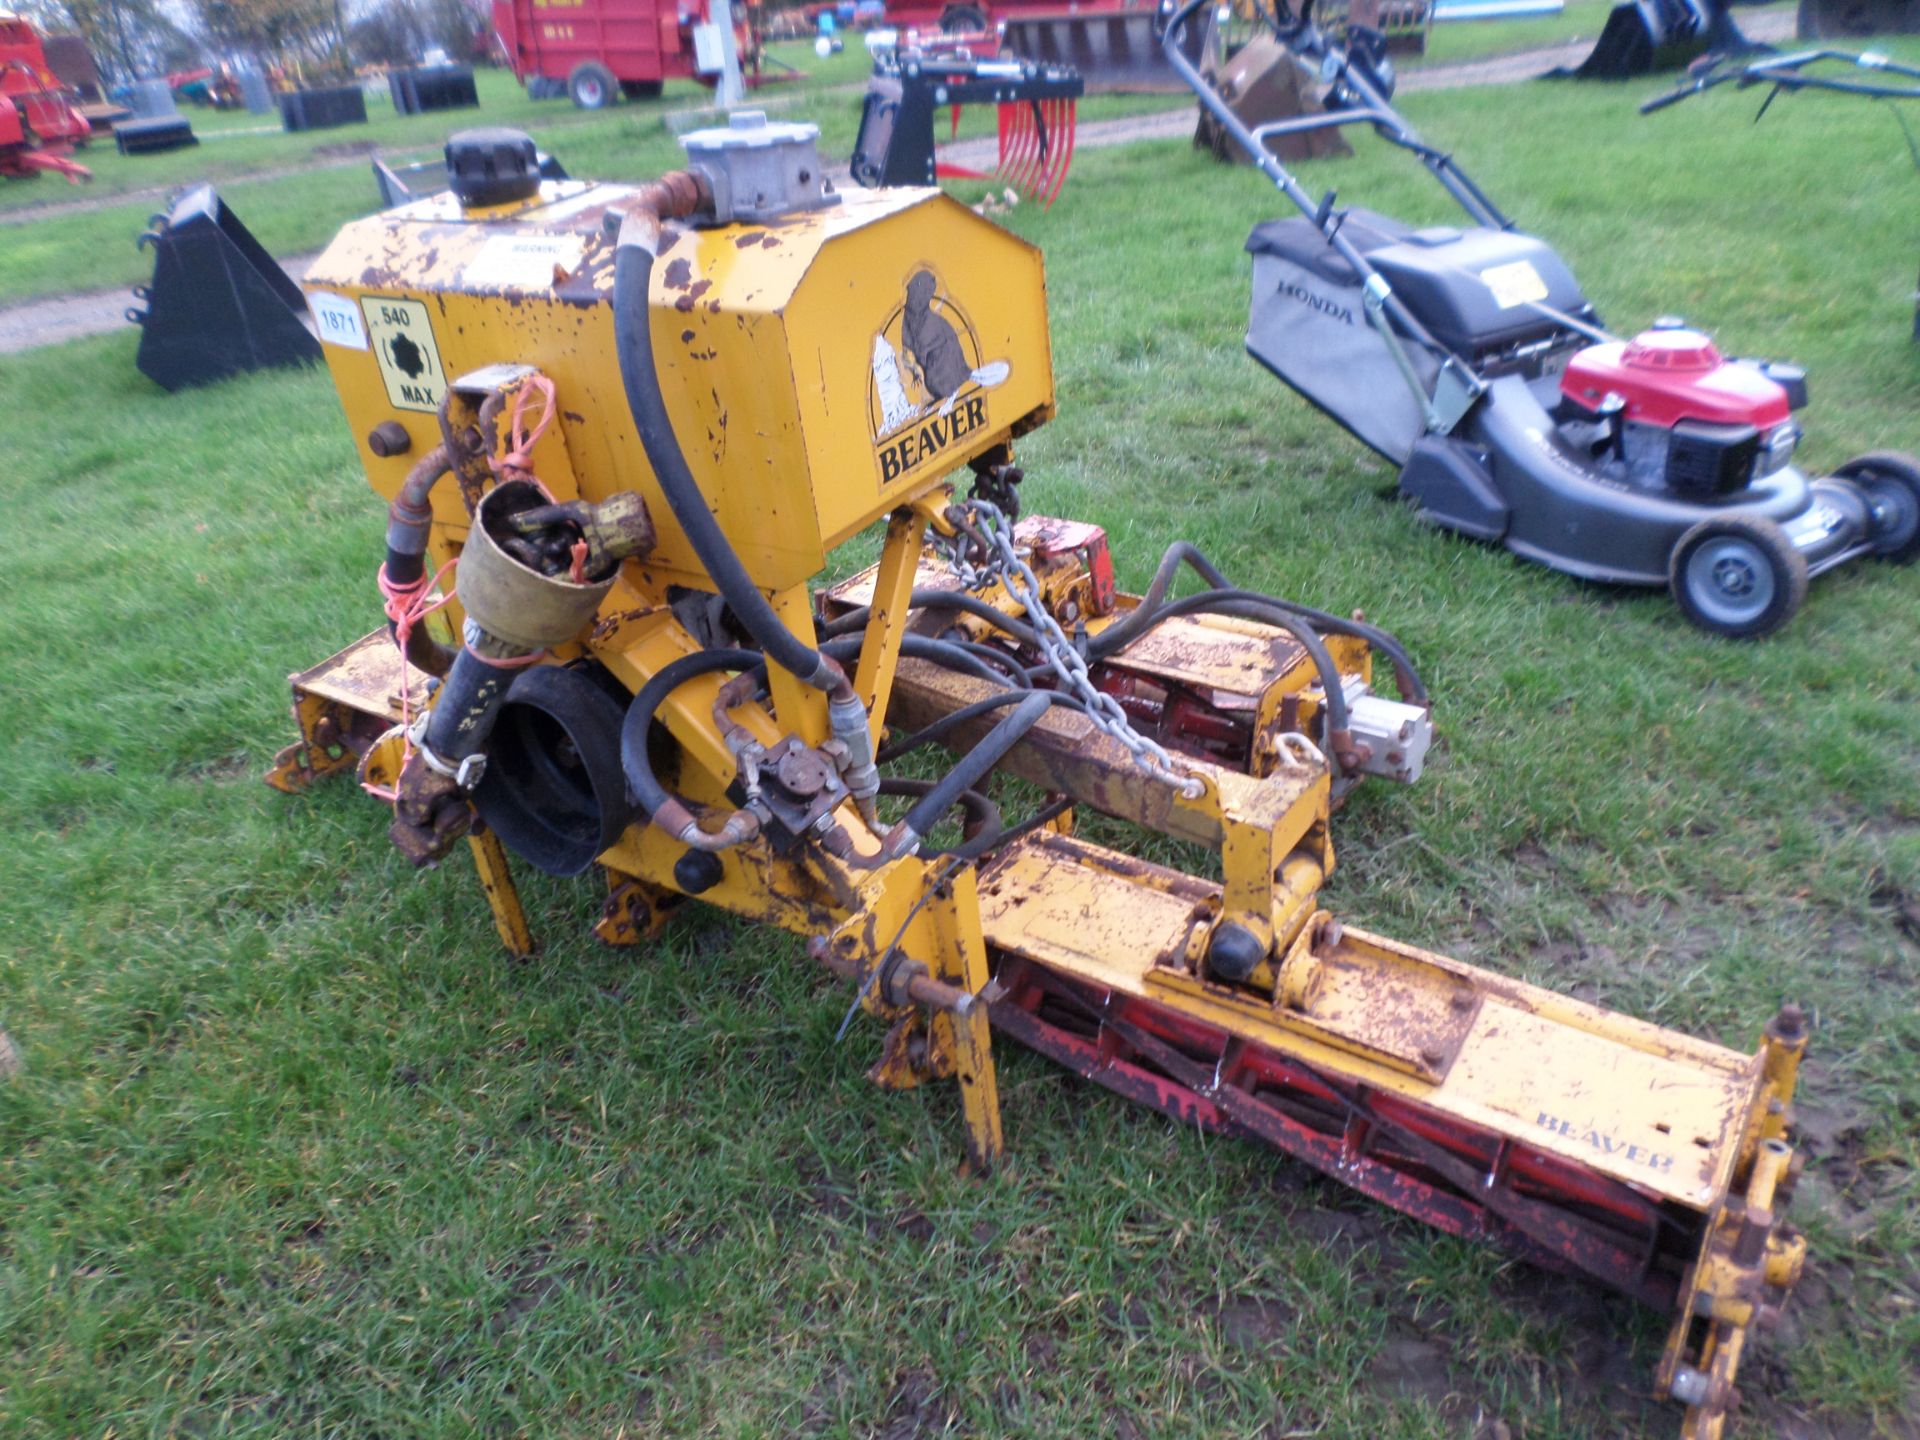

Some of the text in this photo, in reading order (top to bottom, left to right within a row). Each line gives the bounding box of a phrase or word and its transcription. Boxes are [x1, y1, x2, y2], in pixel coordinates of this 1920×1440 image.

[321, 309, 356, 333] 1871
[381, 306, 411, 327] 540
[1277, 280, 1353, 325] HONDA
[879, 396, 985, 485] BEAVER
[1536, 1110, 1674, 1174] BEAVER
